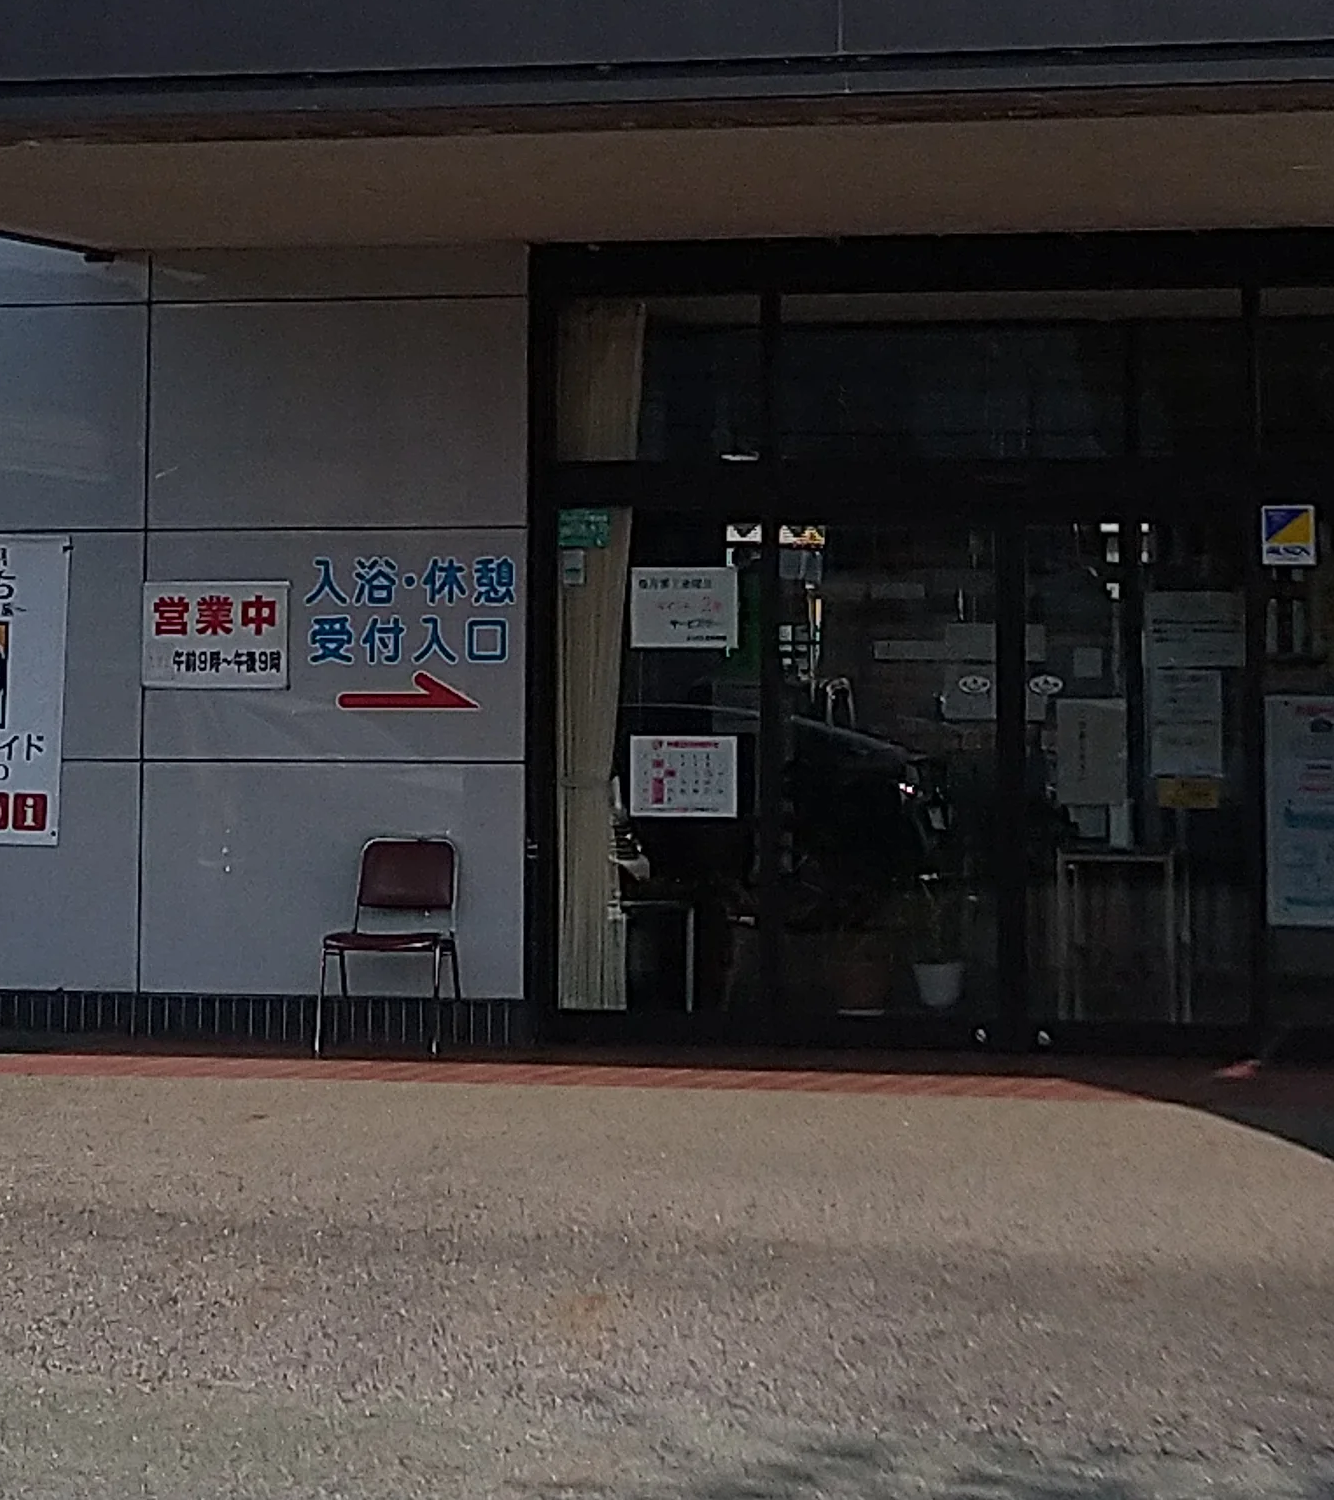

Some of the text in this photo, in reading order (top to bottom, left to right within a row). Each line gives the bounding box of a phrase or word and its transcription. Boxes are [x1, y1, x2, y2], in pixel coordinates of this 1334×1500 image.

[304, 556, 516, 606] 入浴・休憩
[153, 594, 277, 636] 営業中
[308, 615, 509, 665] 受付入口
